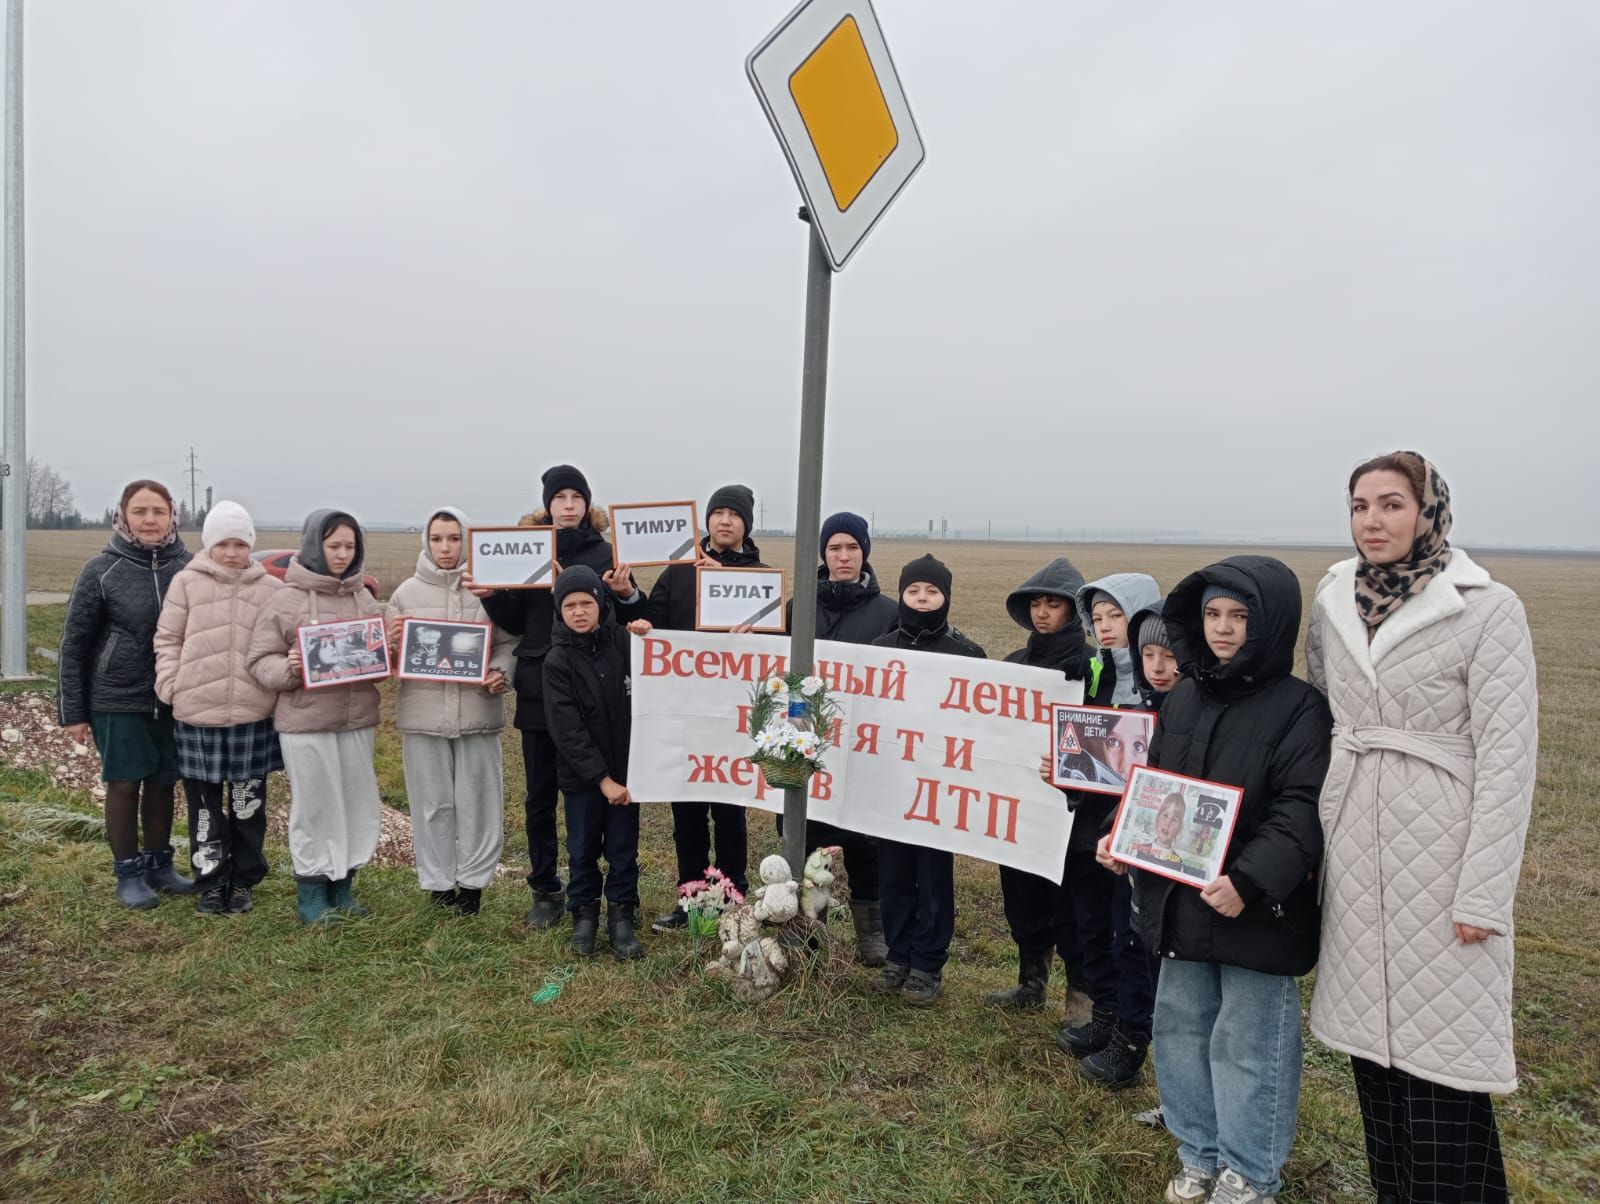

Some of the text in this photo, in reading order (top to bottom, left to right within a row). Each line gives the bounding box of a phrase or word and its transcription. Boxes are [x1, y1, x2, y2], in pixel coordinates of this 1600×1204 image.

[622, 519, 687, 535] ТИМУР
[479, 542, 545, 556] САМАТ
[708, 584, 774, 599] БУЛАТ
[640, 637, 1052, 726] Всеминый день
[1059, 711, 1103, 725] ВНИМАНИЕ
[1084, 726, 1107, 738] ДЕТИ!
[687, 753, 1021, 844] жерв ДТП
